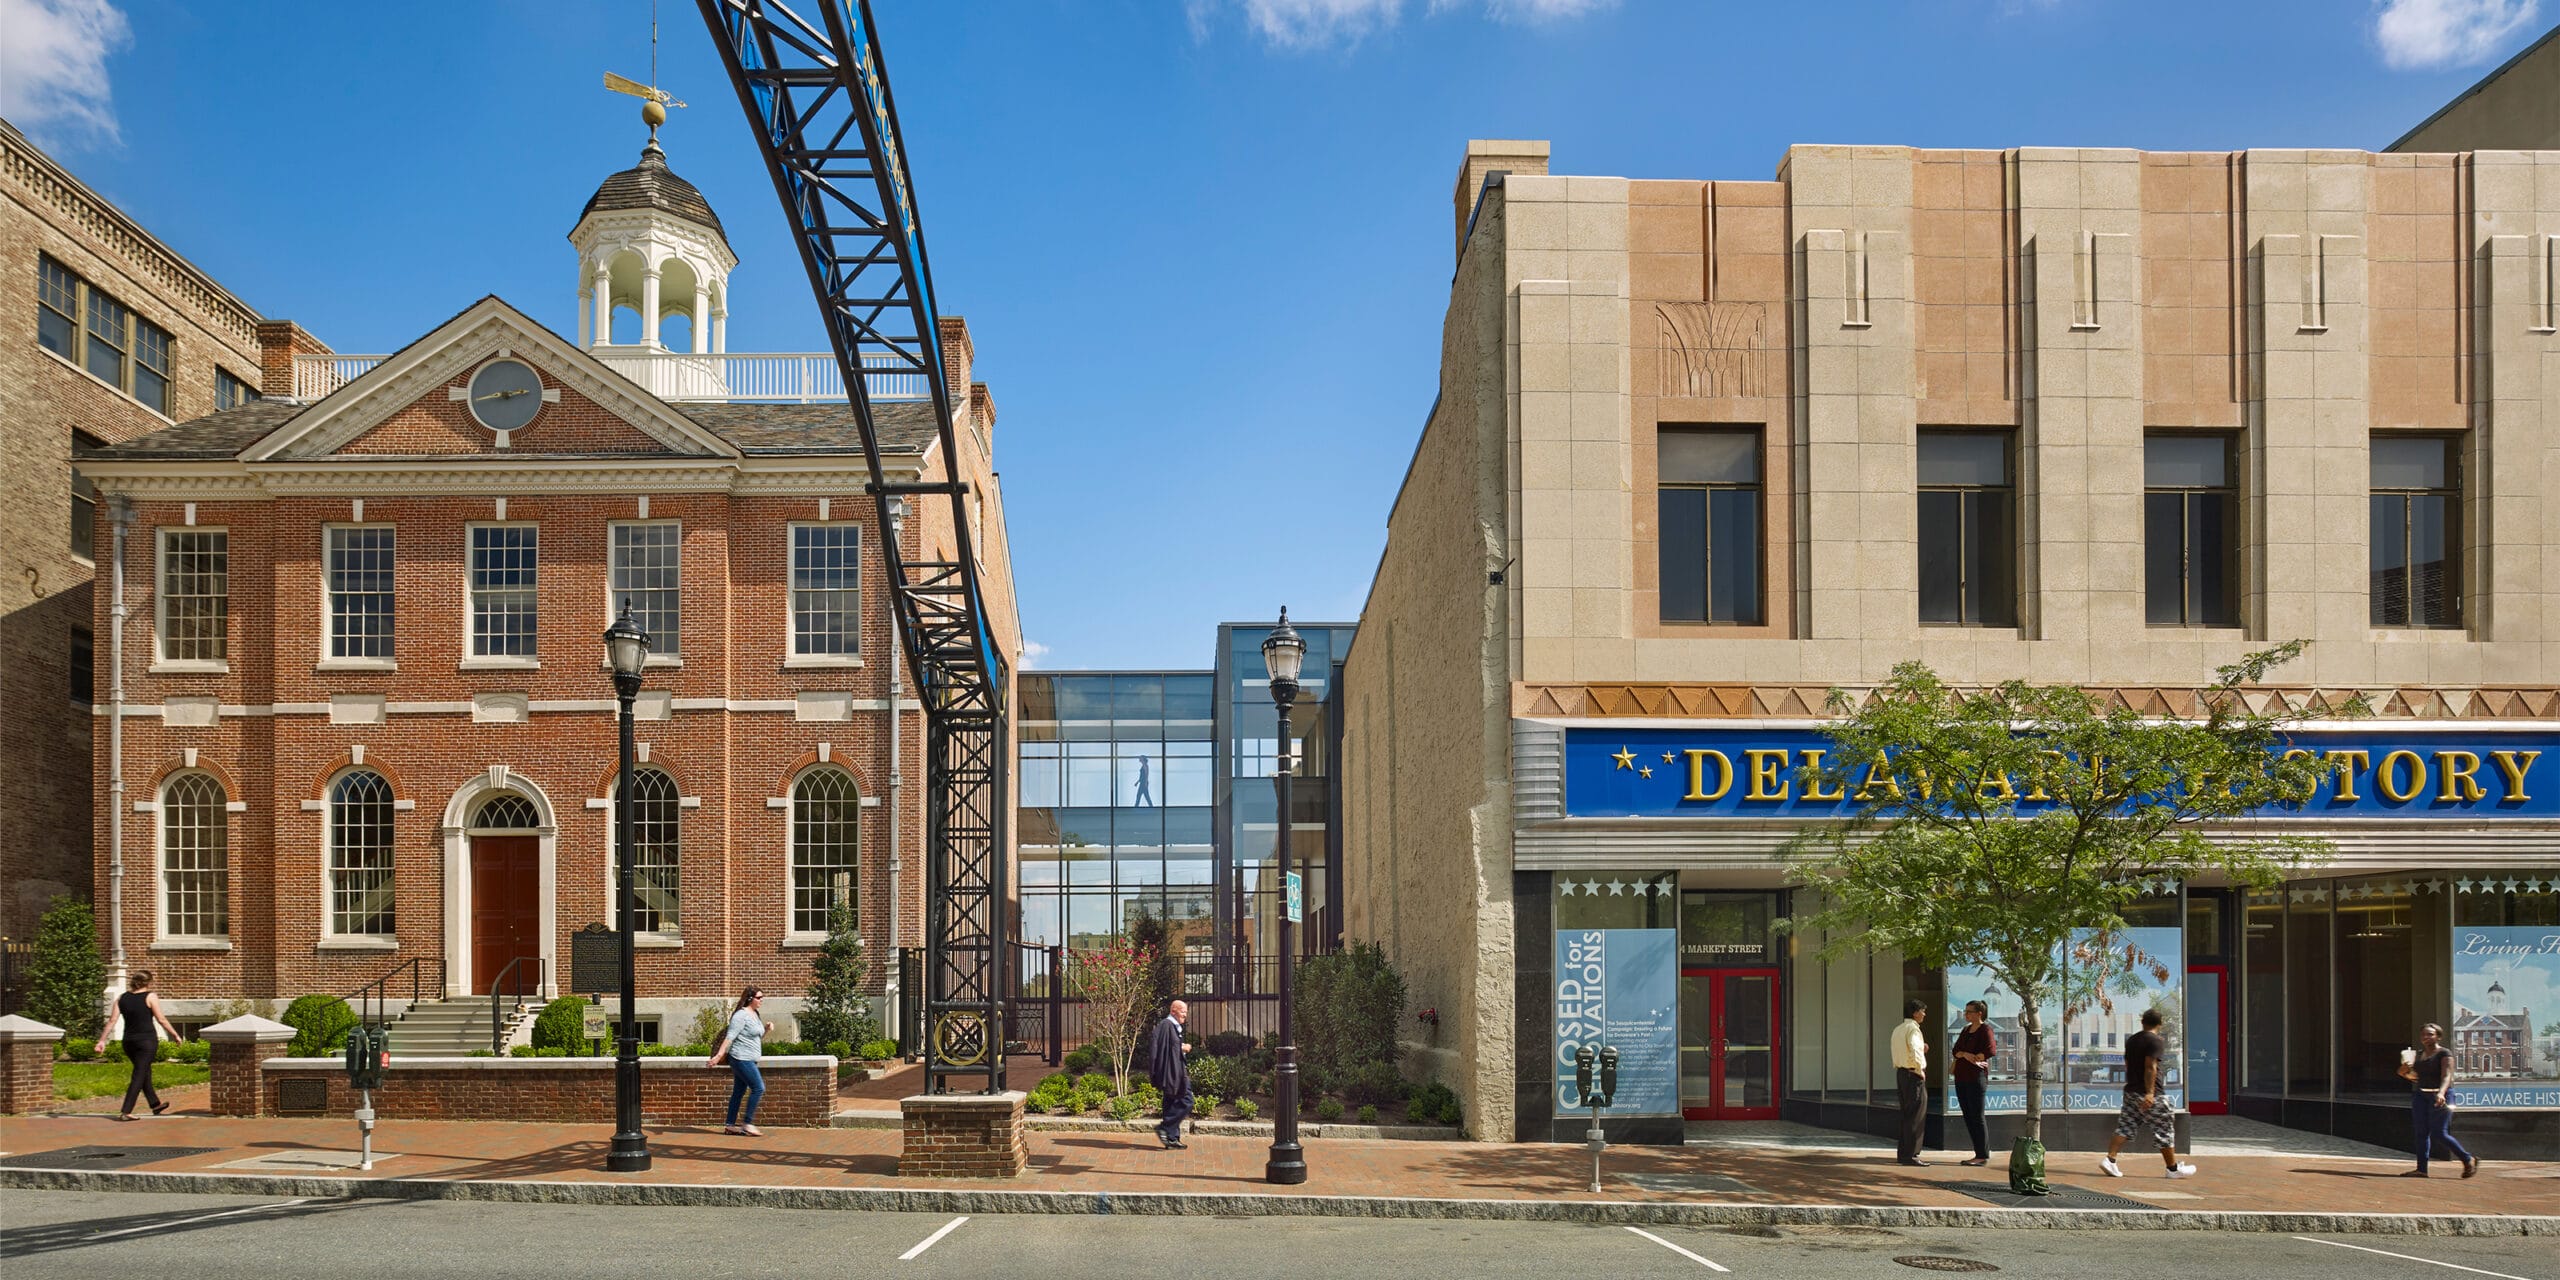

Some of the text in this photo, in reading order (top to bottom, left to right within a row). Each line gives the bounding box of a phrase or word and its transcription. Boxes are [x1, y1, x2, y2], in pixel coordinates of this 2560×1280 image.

[1683, 748, 2543, 802] DELAAR STORY
[1687, 944, 1727, 954] MARKET
[1728, 944, 1763, 954] STREET
[2456, 933, 2532, 969] Living
[1558, 940, 1583, 1110] CLOSED for
[1583, 931, 1603, 1103] ENOVATIONS
[1949, 1094, 2027, 1109] DWARE
[2041, 1094, 2117, 1108] ISTORICAL
[2454, 1092, 2531, 1106] DELAWARE
